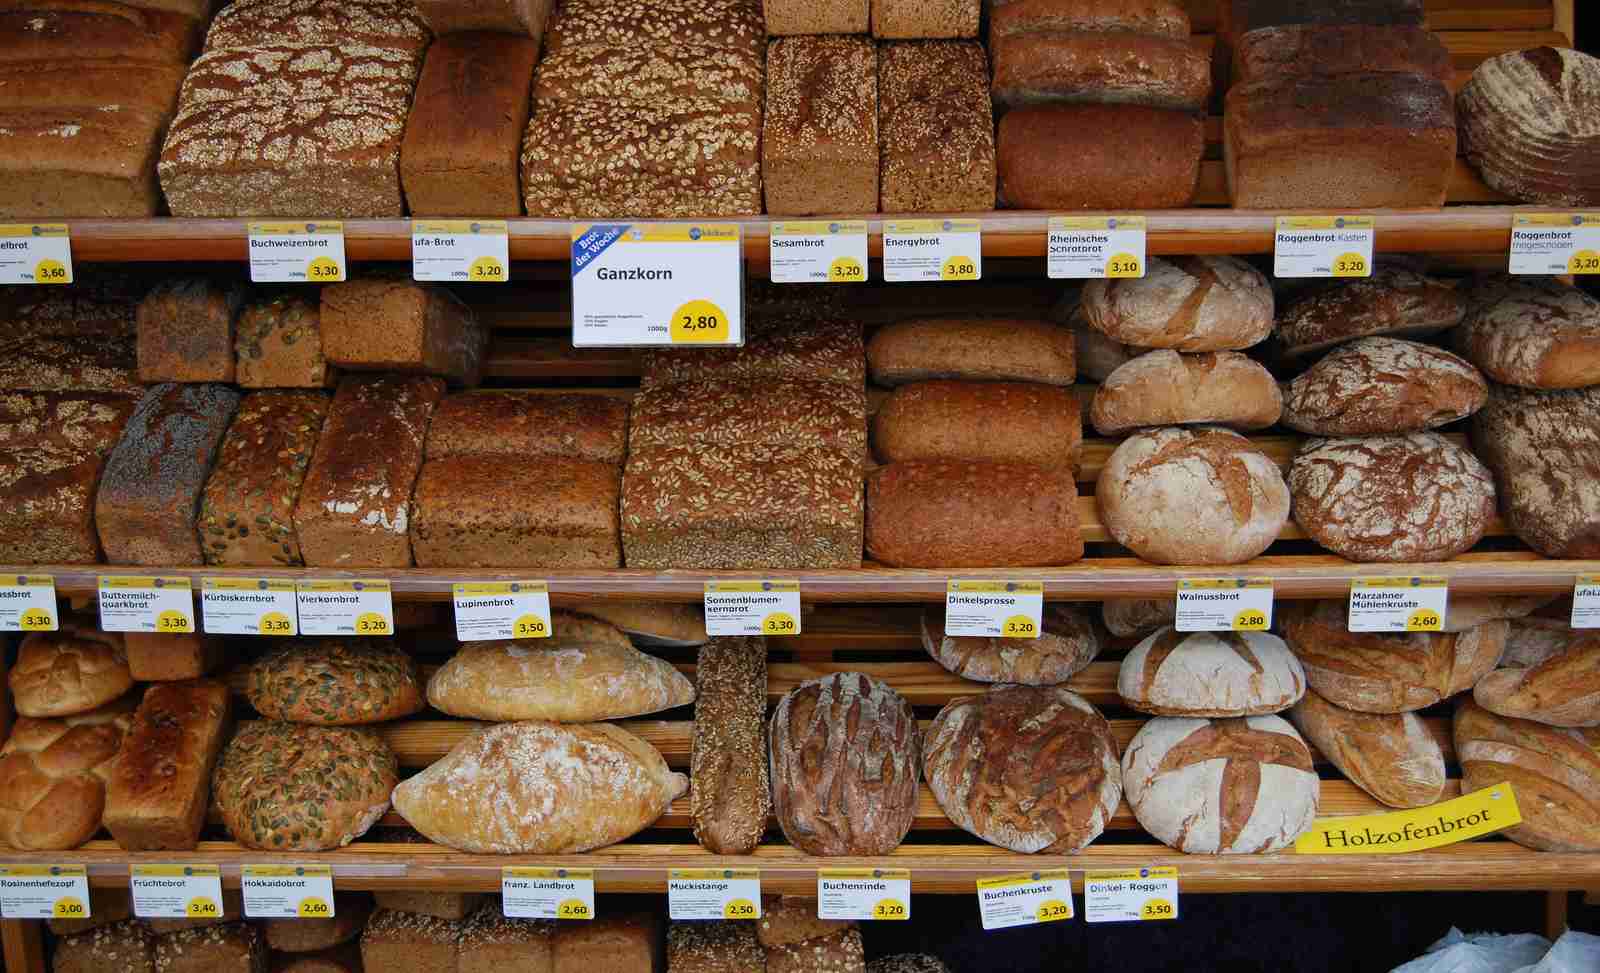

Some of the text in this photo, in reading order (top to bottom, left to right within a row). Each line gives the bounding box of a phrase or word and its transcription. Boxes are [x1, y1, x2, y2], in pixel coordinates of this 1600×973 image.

[579, 231, 600, 249] Brot
[1050, 233, 1109, 243] Rheinisches
[1277, 232, 1336, 243] Roggenbrot
[1514, 230, 1572, 241] Roggenbrot
[251, 239, 328, 248] Buchweizenbrot
[414, 238, 456, 247] ufa-Brot
[575, 226, 620, 266] der Woche
[772, 239, 825, 248] Sesambrot
[885, 237, 940, 248] Energybrot
[1050, 244, 1103, 253] Schrotbrot
[947, 263, 974, 276] 3,80
[1111, 261, 1138, 273] 3,10
[1336, 260, 1364, 272] 3,20
[1573, 257, 1599, 270] 3,20
[40, 268, 65, 280] 3,60
[312, 265, 338, 277] 3,30
[475, 265, 502, 277] 3,20
[597, 267, 673, 281] Ganzkorn
[833, 265, 861, 277] 3,20
[647, 325, 668, 333] 1000g
[682, 315, 718, 334] 2,80
[101, 591, 161, 600] Buttermilch-
[204, 593, 275, 602] Kürbiskernbrot
[299, 595, 361, 604] Vierkornbrot
[705, 595, 782, 605] Sonnenblumen-
[949, 595, 1016, 606] Dinkelsprosse
[1179, 592, 1240, 601] Walnussbrot
[1352, 591, 1405, 600] Marzahner
[101, 600, 149, 610] quarkbrot
[456, 599, 513, 609] Lupinenbrot
[707, 604, 750, 613] kernbrot
[1352, 599, 1419, 609] Mühlenkruste
[26, 615, 51, 627] 3,30
[161, 617, 188, 629] 3,30
[264, 620, 290, 631] 3,30
[360, 620, 387, 632] 3,20
[767, 620, 794, 632] 3,30
[1239, 616, 1265, 628] 2,80
[1412, 616, 1438, 628] 2,60
[519, 622, 544, 635] 3,50
[1007, 622, 1034, 635] 3,20
[1324, 808, 1490, 848] Holzofenbrot
[1, 879, 75, 889] Rosinenhefezopf
[134, 879, 186, 888] Früchtebrot
[245, 879, 305, 888] Hokkaidobrot
[533, 880, 577, 890] Landbrot
[671, 882, 729, 892] Muckistange
[823, 881, 887, 891] Buchenrinde
[1090, 882, 1168, 893] Dinkel- Roggen
[983, 884, 1053, 901] Buchenkruste
[57, 903, 83, 915] 3,00
[191, 902, 217, 914] 3,40
[303, 902, 329, 914] 2,60
[563, 904, 588, 916] 2,60
[730, 904, 754, 916] 2,50
[877, 904, 905, 917] 3,20
[1040, 903, 1068, 919] 3,20
[1145, 904, 1171, 916] 3,50
